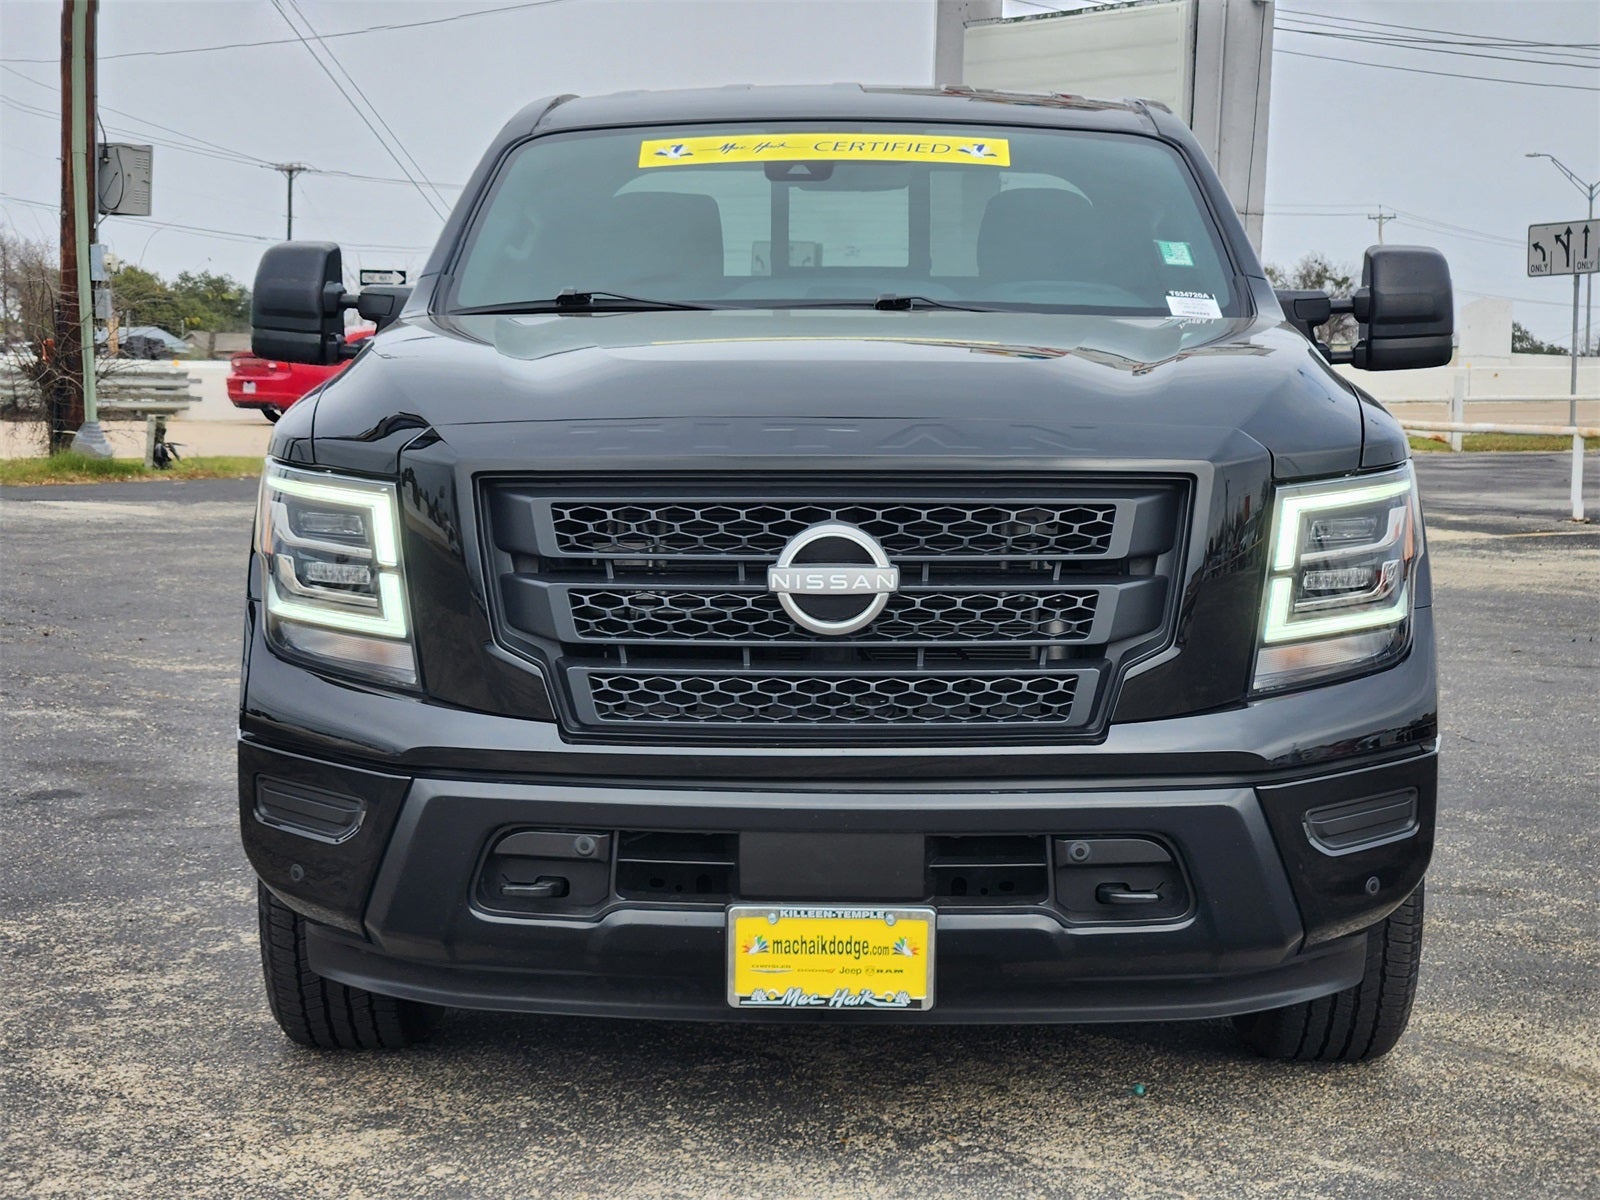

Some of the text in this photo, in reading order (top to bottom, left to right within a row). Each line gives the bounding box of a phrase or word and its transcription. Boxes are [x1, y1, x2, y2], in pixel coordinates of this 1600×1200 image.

[813, 141, 951, 154] CERTIFIED
[1530, 264, 1548, 273] ONLY
[1577, 260, 1594, 270] ONLY
[771, 573, 895, 590] NISSAN
[772, 936, 890, 959] machaikdodge.com
[780, 987, 876, 1008] Mac Haik
